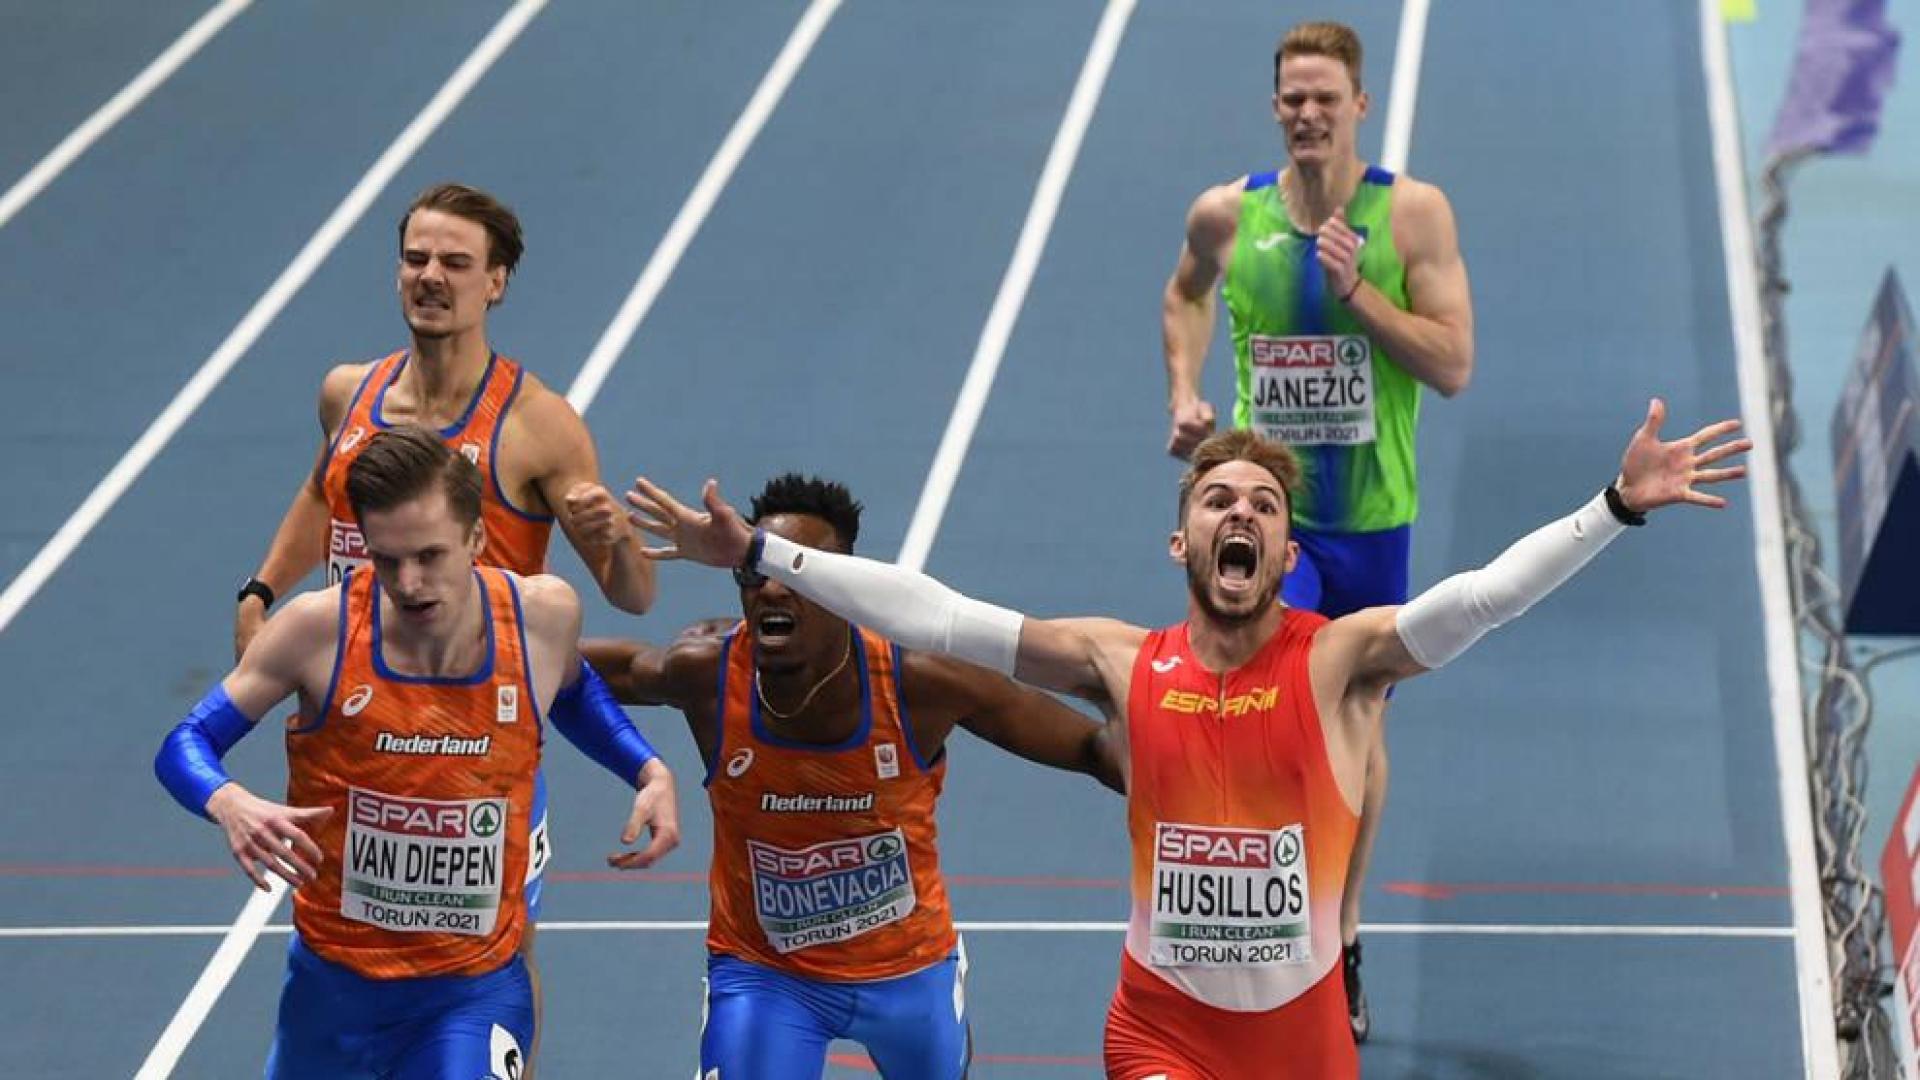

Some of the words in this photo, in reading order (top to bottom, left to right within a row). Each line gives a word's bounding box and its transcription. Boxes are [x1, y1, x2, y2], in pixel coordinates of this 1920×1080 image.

[1254, 340, 1333, 364] SPAR
[1254, 369, 1366, 408] JANEŽIČ
[356, 798, 465, 834] SPAR
[352, 831, 398, 881] VAN
[404, 843, 497, 887] DIEPEN
[534, 829, 544, 868] 5
[753, 846, 862, 875] SPAR
[1160, 831, 1267, 864] SPAR
[758, 861, 905, 917] BONEVACIA
[1157, 870, 1303, 918] HUSILLOS
[434, 912, 480, 930] 2021
[856, 905, 897, 931] 2021
[1189, 926, 1221, 939] RUN
[1248, 943, 1291, 963] 2021
